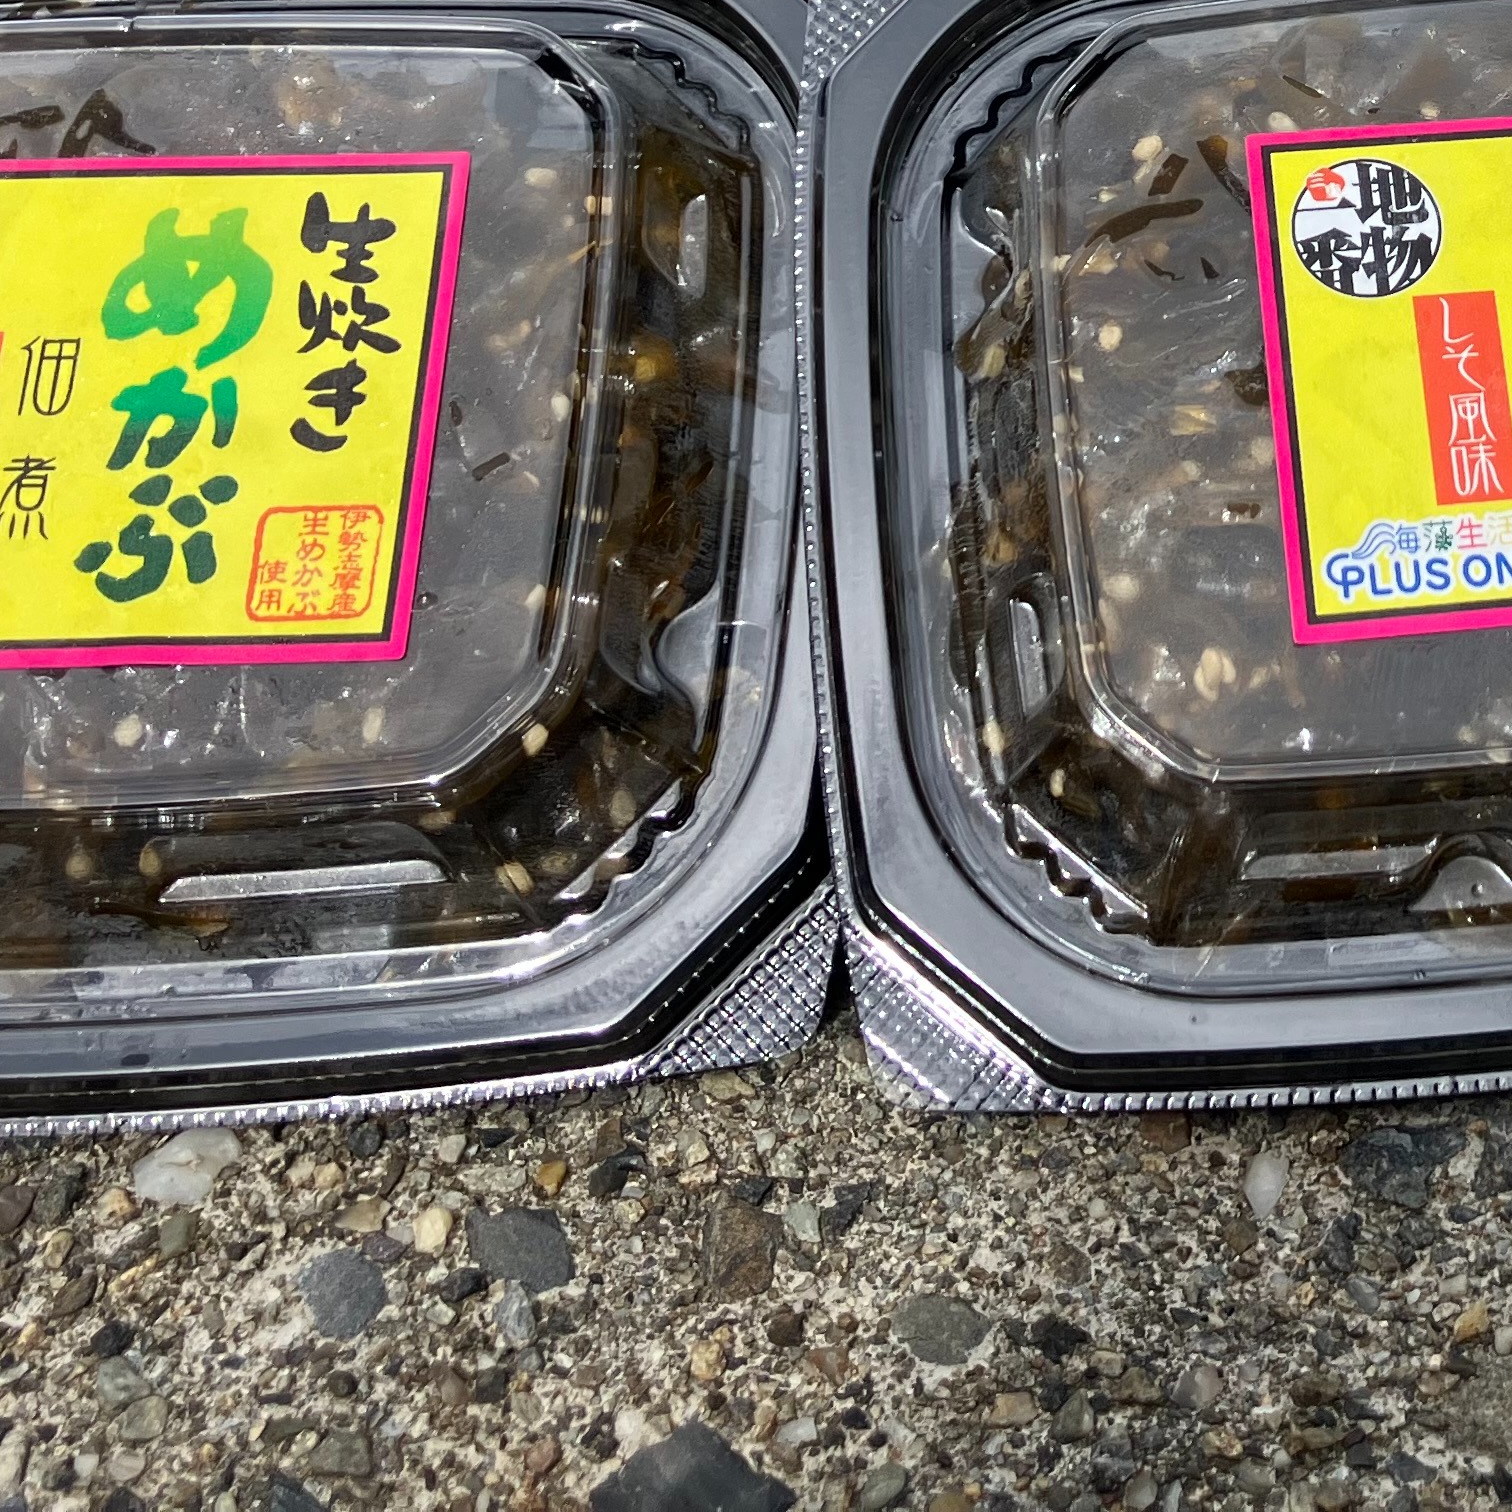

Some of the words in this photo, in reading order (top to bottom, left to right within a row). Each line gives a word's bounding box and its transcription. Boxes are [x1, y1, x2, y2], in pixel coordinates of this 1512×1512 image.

[73, 207, 274, 603] めかぶ
[290, 192, 402, 452] 生炊き
[1439, 296, 1505, 496] しそ風味
[0, 336, 81, 539] 佃煮
[255, 560, 288, 611] 使用
[287, 510, 329, 616] 生めかぶ
[1326, 553, 1451, 598] PLUS
